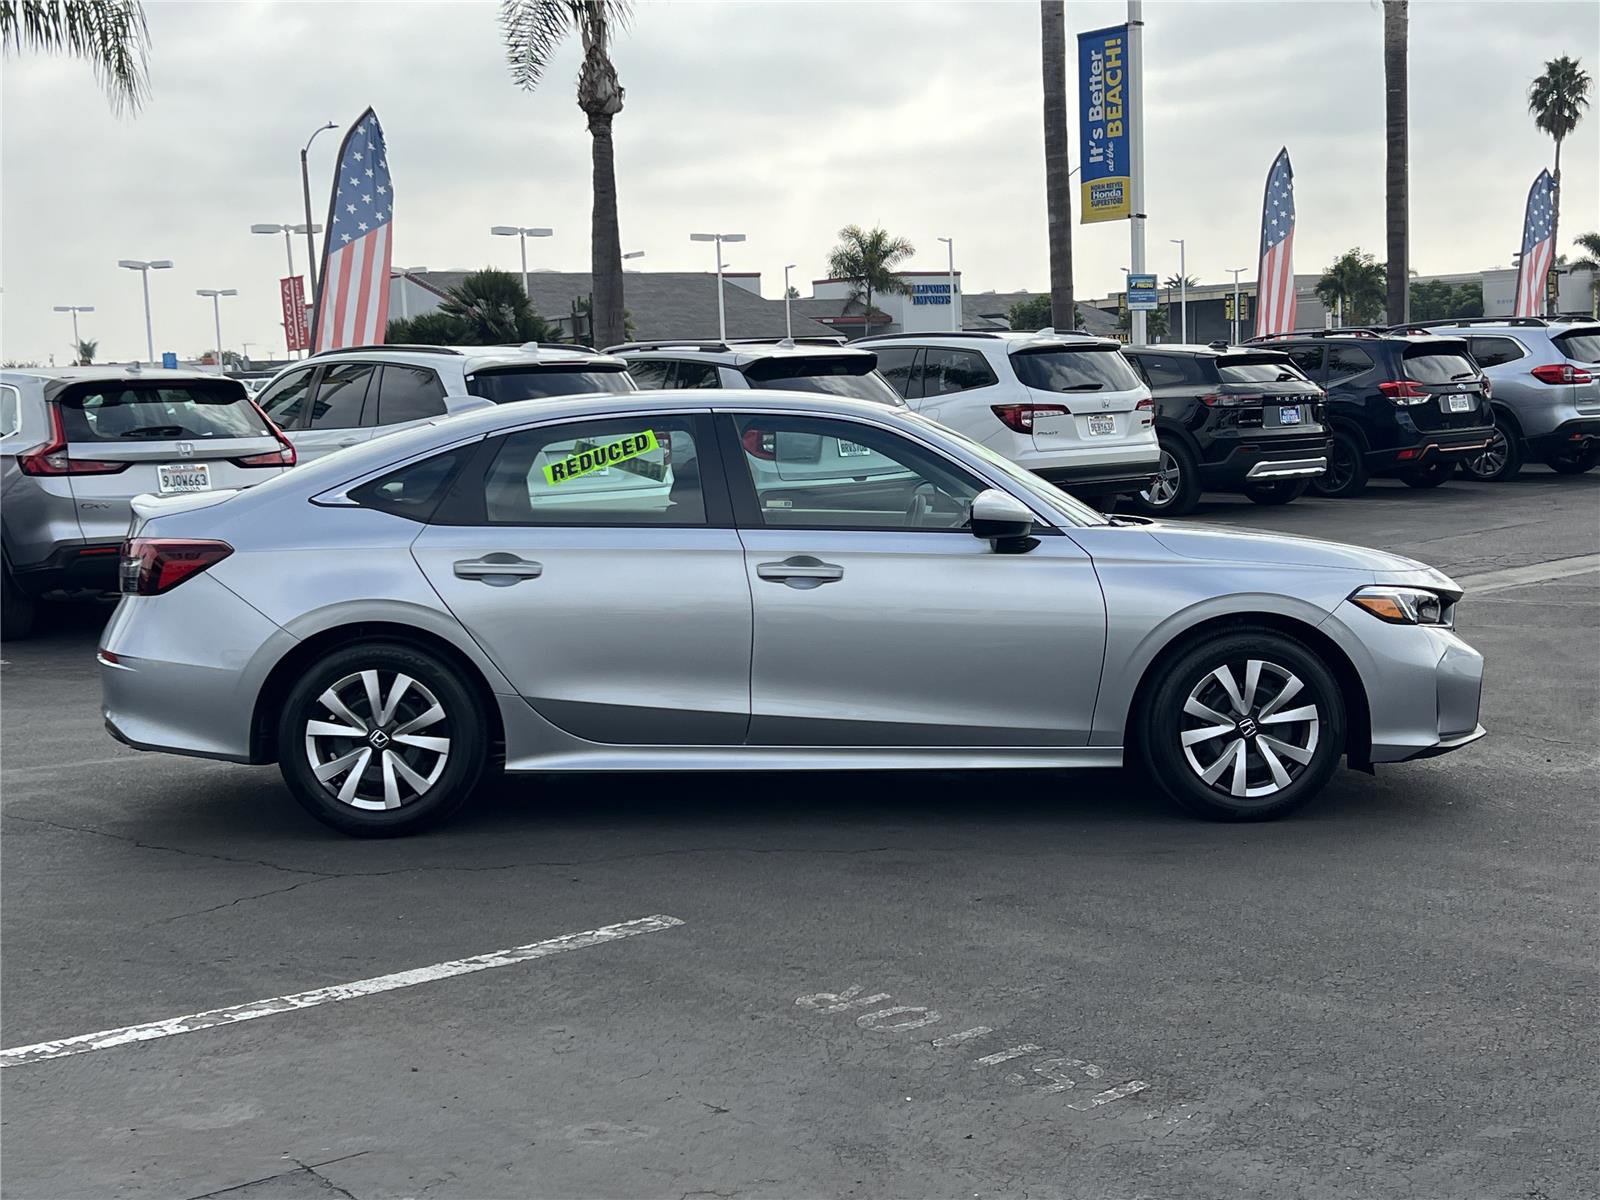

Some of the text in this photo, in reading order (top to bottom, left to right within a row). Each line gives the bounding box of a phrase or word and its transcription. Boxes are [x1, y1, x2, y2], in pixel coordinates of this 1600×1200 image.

[1105, 38, 1123, 138] BEACH!
[1088, 50, 1104, 163] It's Better
[1105, 141, 1114, 158] the
[1090, 198, 1123, 207] SUPERSTORE
[1092, 189, 1122, 200] Honda
[284, 283, 295, 345] TOYOTA
[912, 295, 951, 305] IMPORTS
[551, 433, 649, 482] REDUCED
